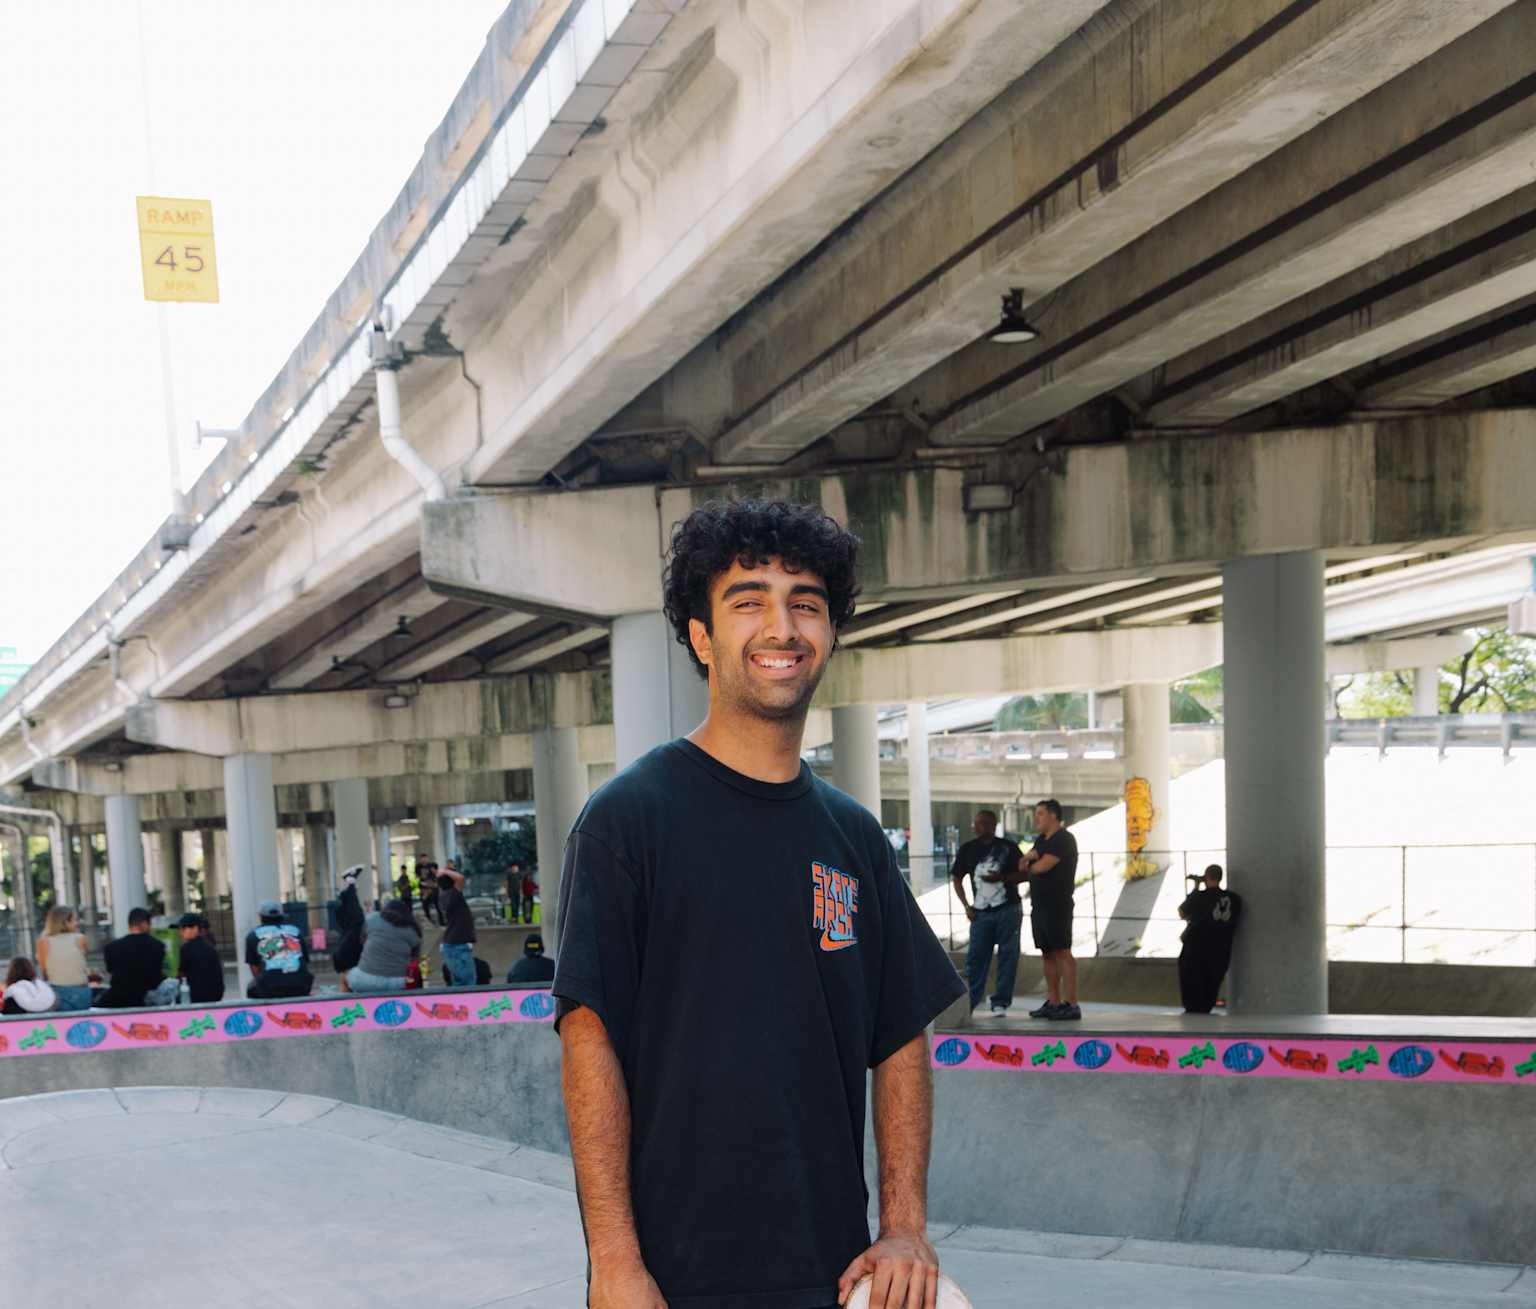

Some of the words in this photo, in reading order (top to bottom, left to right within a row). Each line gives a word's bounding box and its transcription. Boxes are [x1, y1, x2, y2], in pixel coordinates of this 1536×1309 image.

[146, 207, 204, 226] RAMP
[154, 244, 205, 273] 45
[811, 861, 859, 913] SKATE
